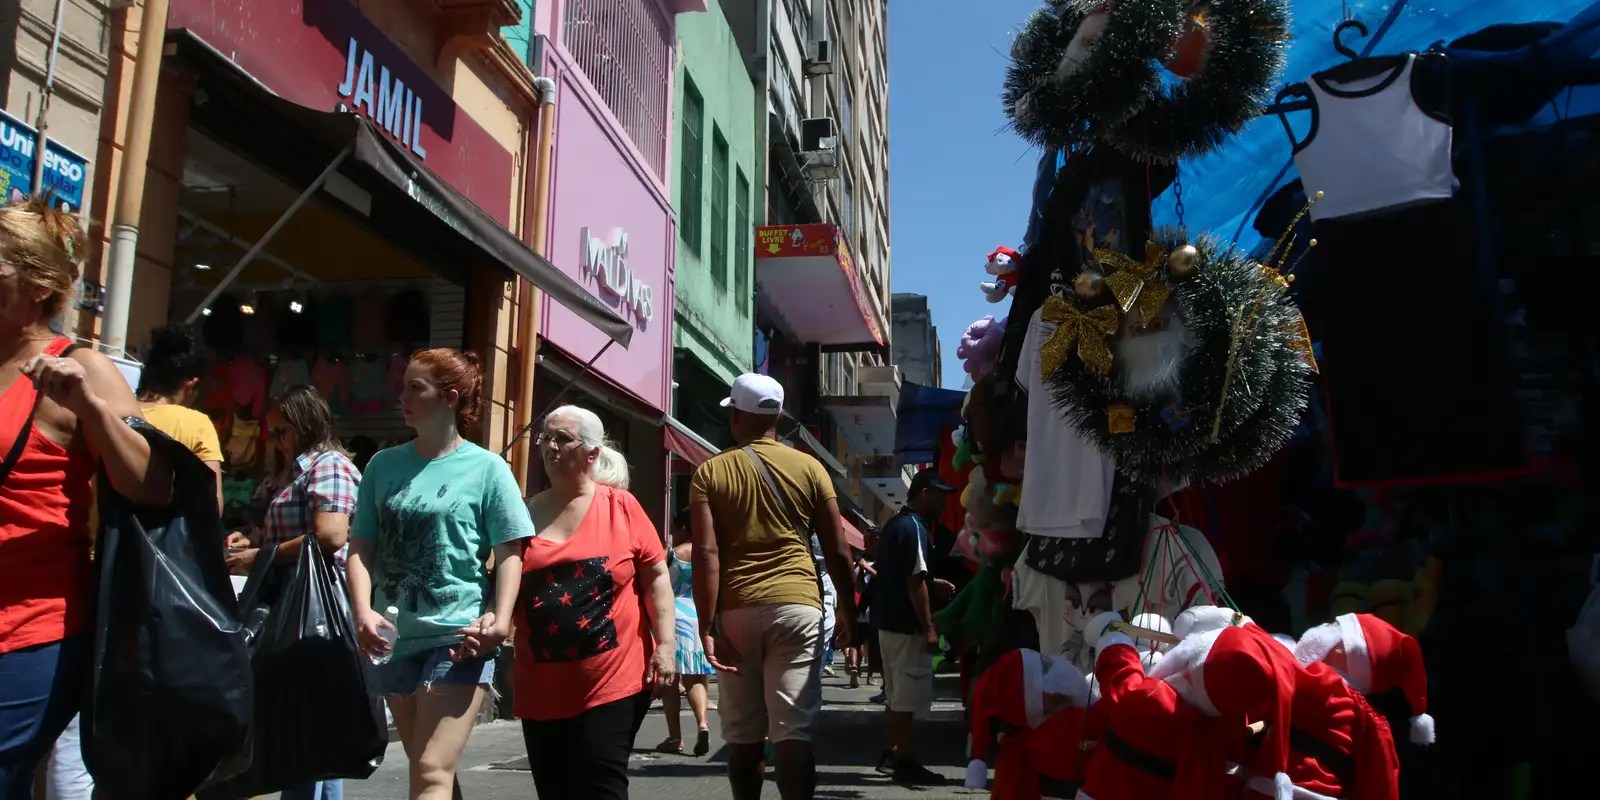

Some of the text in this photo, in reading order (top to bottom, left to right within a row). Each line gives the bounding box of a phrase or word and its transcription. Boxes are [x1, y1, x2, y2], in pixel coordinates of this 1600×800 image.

[338, 36, 427, 160] JAMIL
[0, 121, 82, 181] Unierso
[27, 158, 78, 196] Clular
[759, 229, 788, 237] BUFFET
[762, 236, 785, 244] LIVRE
